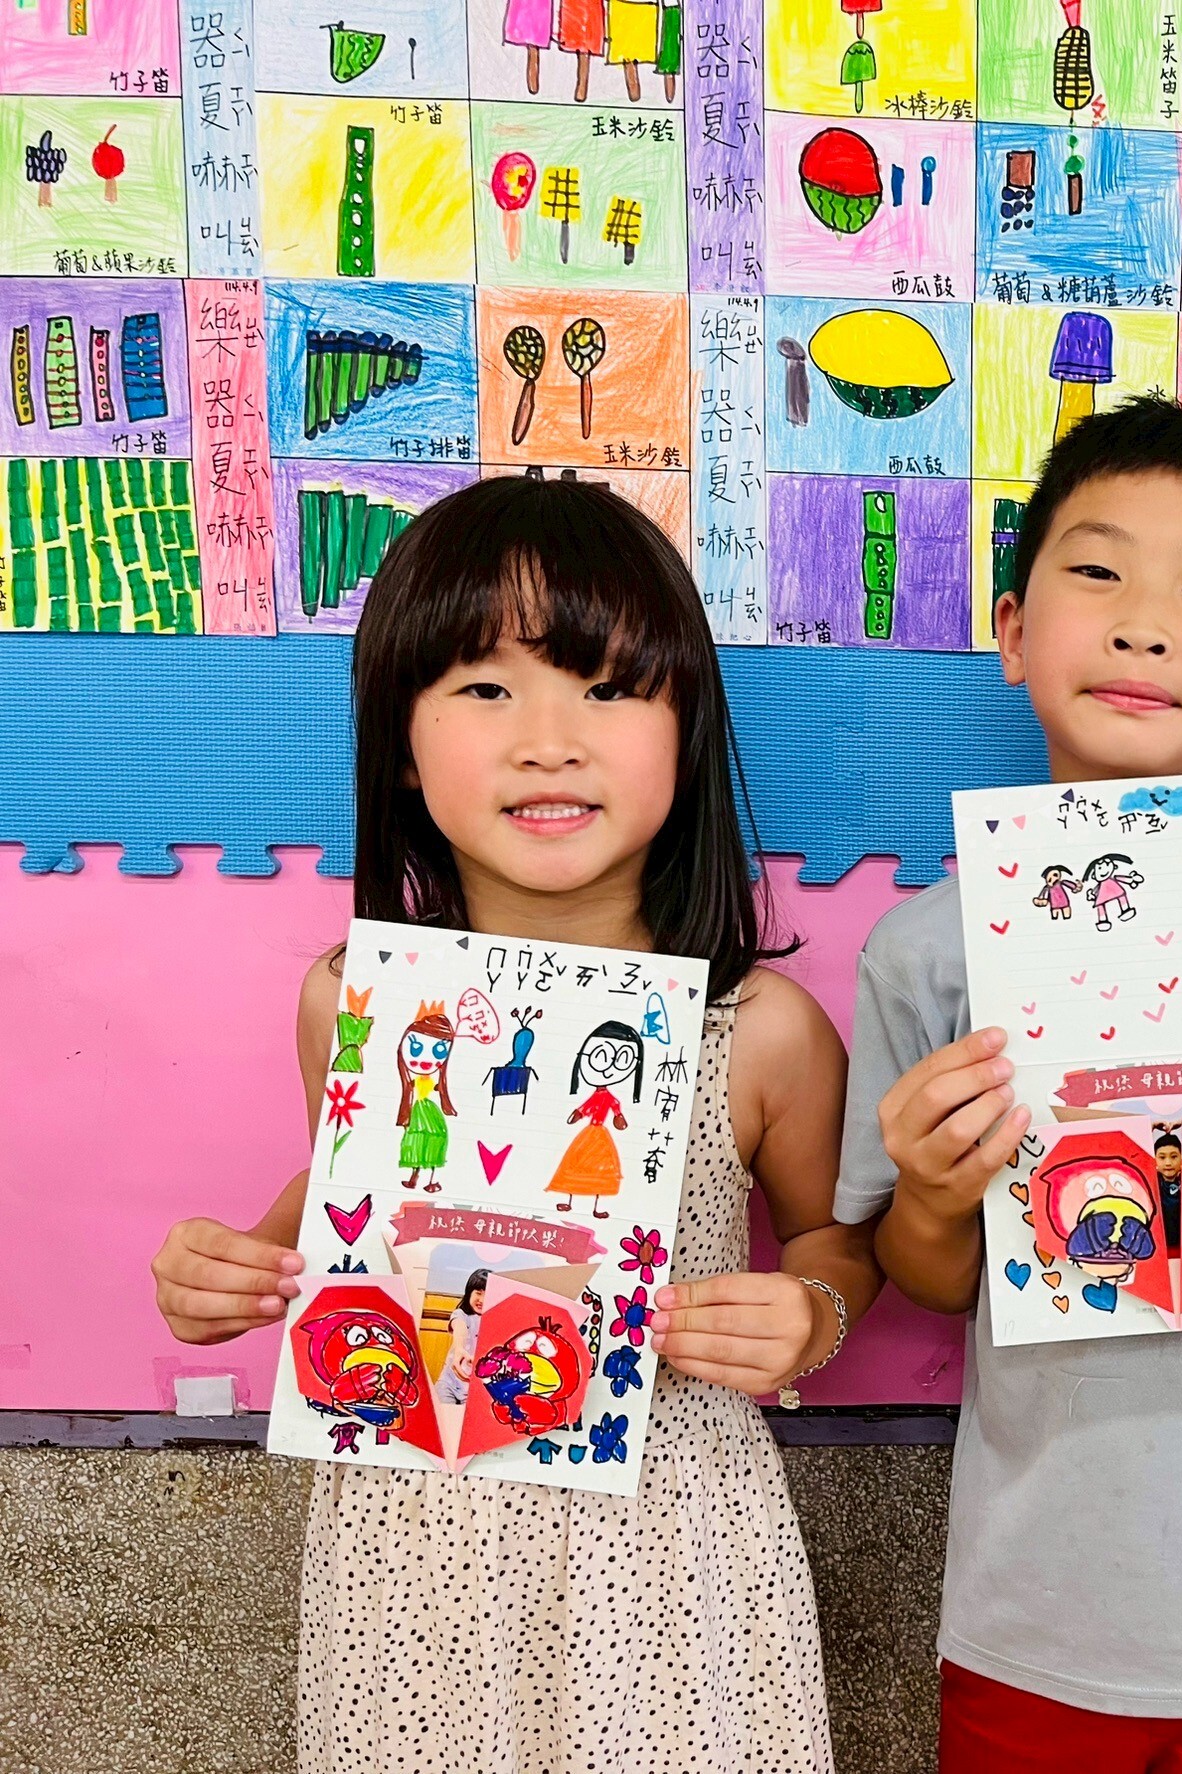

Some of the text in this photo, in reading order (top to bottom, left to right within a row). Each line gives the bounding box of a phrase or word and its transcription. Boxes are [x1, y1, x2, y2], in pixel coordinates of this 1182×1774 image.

[110, 69, 170, 93] 竹子笛
[390, 102, 443, 126] 竹子笛
[884, 90, 974, 121] 冰棒沙鈴
[592, 116, 676, 142] 玉米沙鈴
[224, 281, 259, 295] 114.4.9
[892, 270, 956, 298] 西瓜鼓
[727, 297, 759, 313] 114.4.9
[112, 434, 167, 454] 竹子笛
[391, 435, 471, 458] 竹子排笛
[604, 443, 682, 467] 玉米沙鈴
[889, 455, 946, 475] 西瓜鼓
[776, 621, 832, 643] 竹子笛
